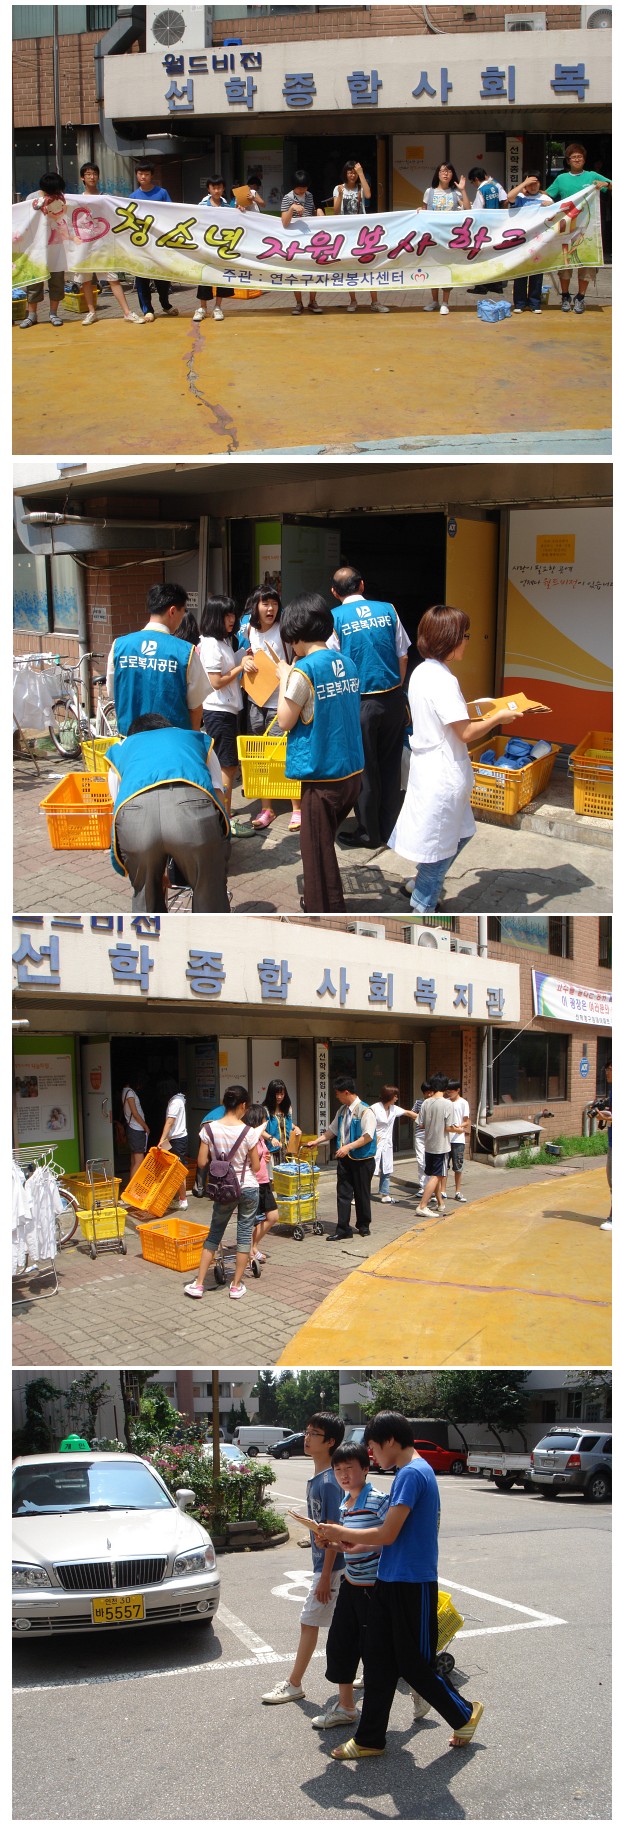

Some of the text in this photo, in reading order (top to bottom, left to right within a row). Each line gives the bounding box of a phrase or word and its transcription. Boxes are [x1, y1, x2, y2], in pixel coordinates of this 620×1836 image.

[161, 51, 263, 75] 월드비전
[111, 202, 245, 260] 청소년
[256, 224, 437, 265] 자원봉사
[222, 268, 252, 285] 주관
[270, 270, 404, 287] 연수구자원봉사센터
[119, 655, 178, 673] 근로복지공단
[105, 1598, 118, 1606] 인천
